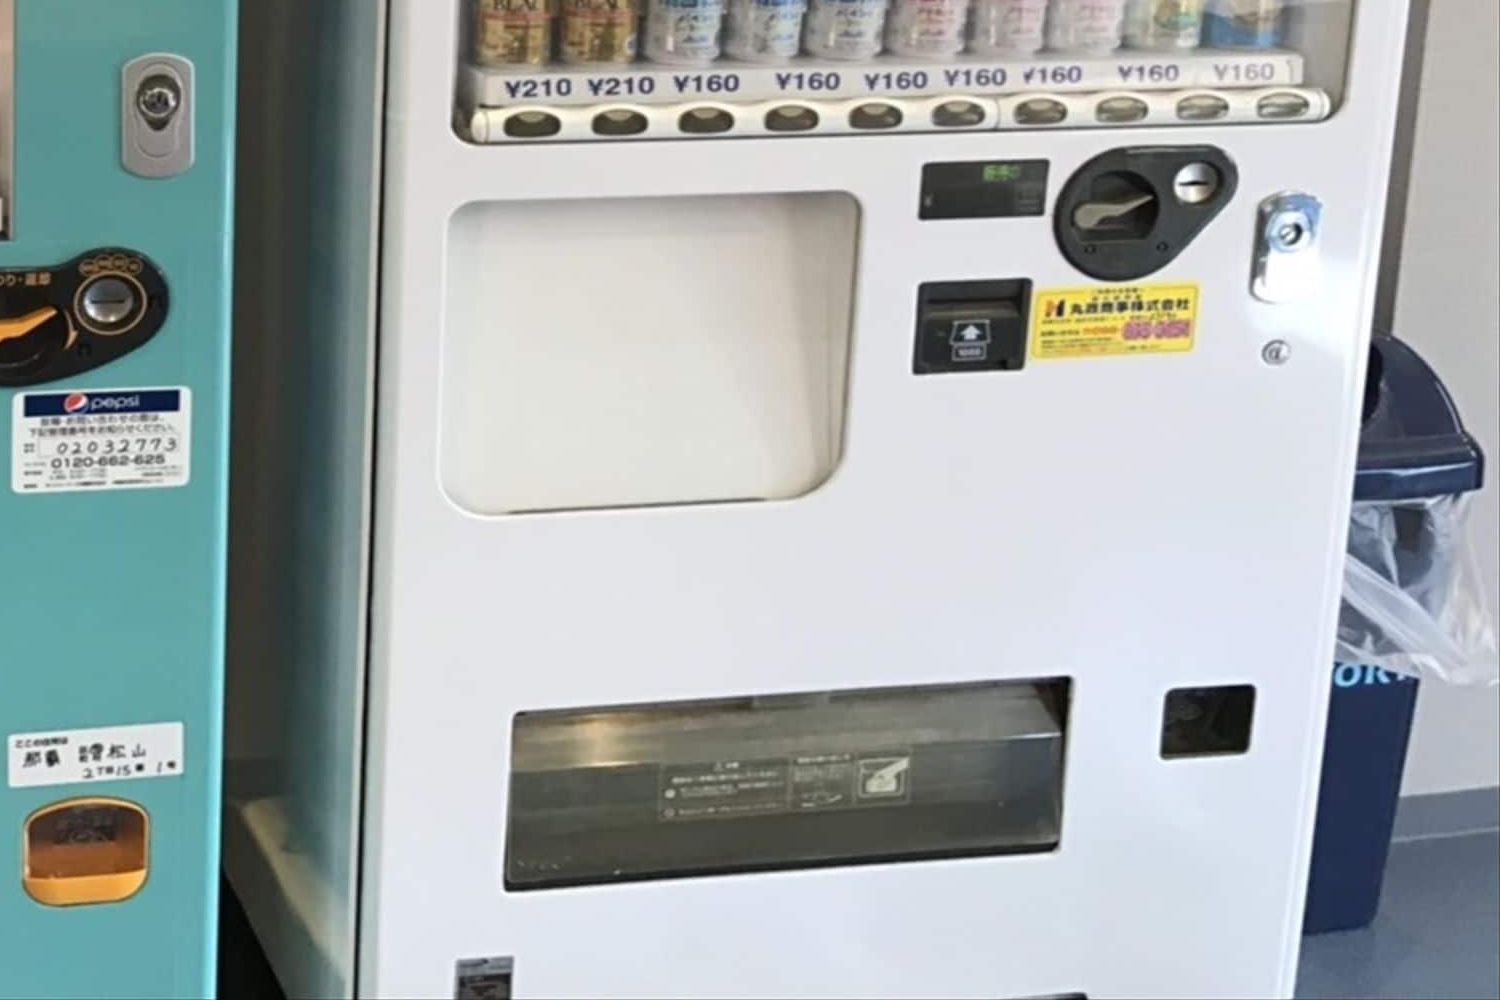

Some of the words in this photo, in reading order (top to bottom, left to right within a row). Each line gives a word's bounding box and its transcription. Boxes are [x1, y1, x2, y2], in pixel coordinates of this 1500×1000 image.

[864, 71, 928, 90] ¥160
[944, 68, 1007, 87] ¥160
[1118, 64, 1180, 82] ¥160
[1213, 62, 1275, 81] ¥160
[504, 79, 573, 98] ¥210
[587, 77, 656, 96] ¥210
[673, 75, 740, 93] ¥160
[776, 73, 841, 91] ¥160
[91, 395, 141, 411] pepsi
[1334, 663, 1409, 688] OR
